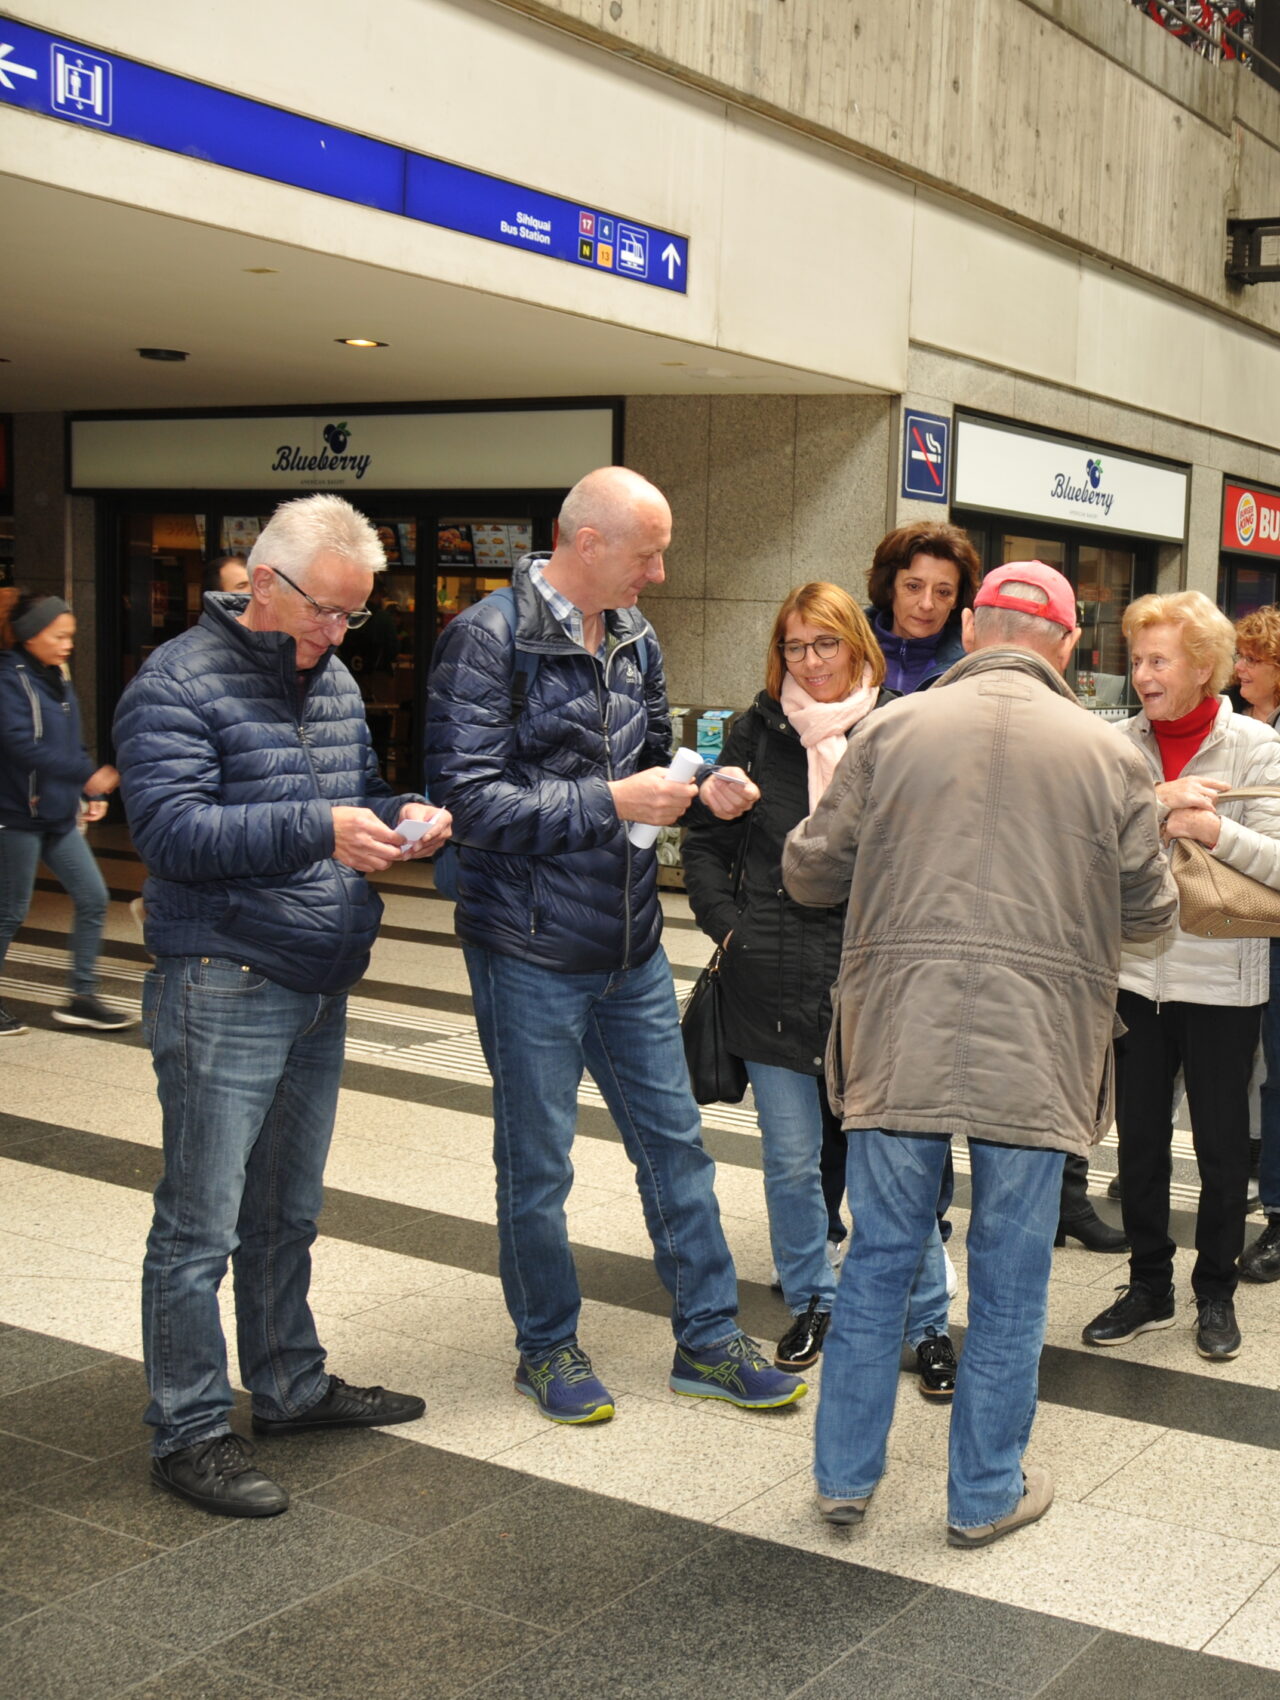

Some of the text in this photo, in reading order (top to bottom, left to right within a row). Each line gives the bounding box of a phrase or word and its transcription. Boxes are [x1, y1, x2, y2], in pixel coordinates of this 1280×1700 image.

[516, 211, 551, 231] Sihlquai
[582, 218, 592, 230] 17
[500, 220, 551, 245] Bus Station
[582, 245, 590, 256] N
[601, 251, 610, 262] 13
[272, 445, 371, 480] Blueberry
[1051, 473, 1114, 516] Blueberry
